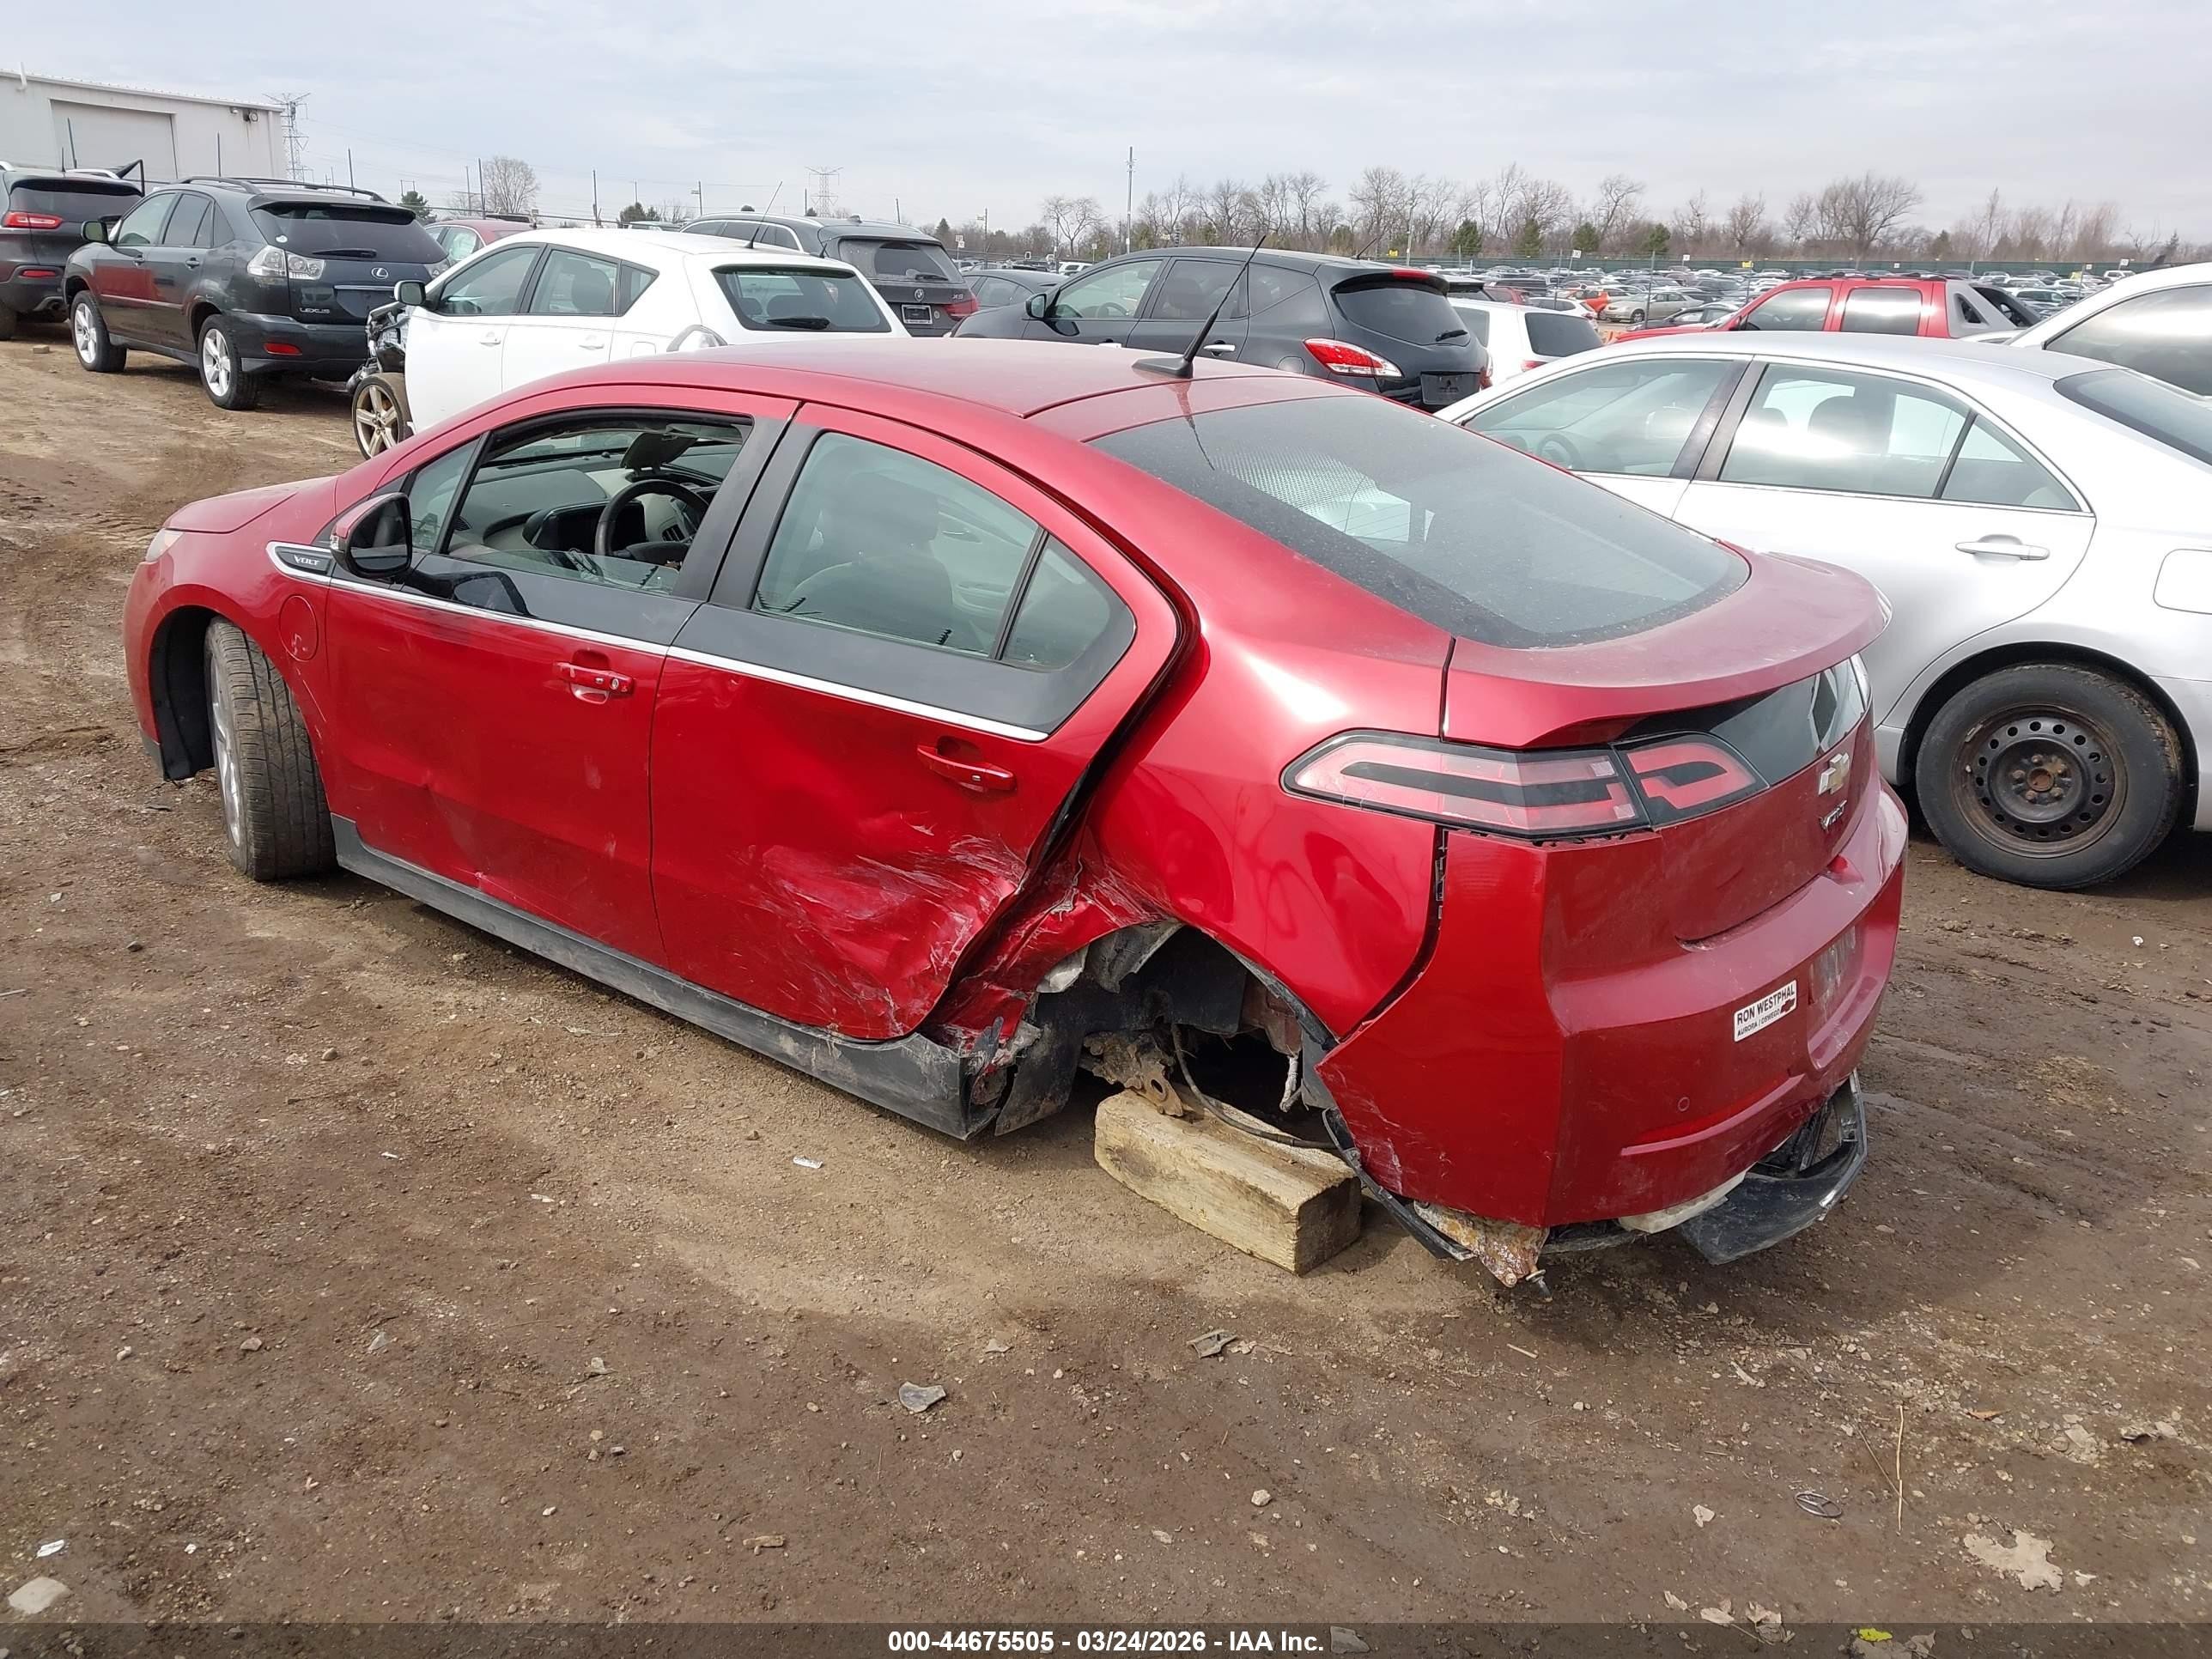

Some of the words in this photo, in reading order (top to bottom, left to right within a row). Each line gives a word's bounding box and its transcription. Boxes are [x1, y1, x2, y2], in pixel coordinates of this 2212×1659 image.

[294, 554, 320, 566] VOLT
[1737, 1006, 1755, 1025] RON
[1757, 984, 1796, 1015] WESTPHAL
[1737, 1021, 1758, 1036] AURORA
